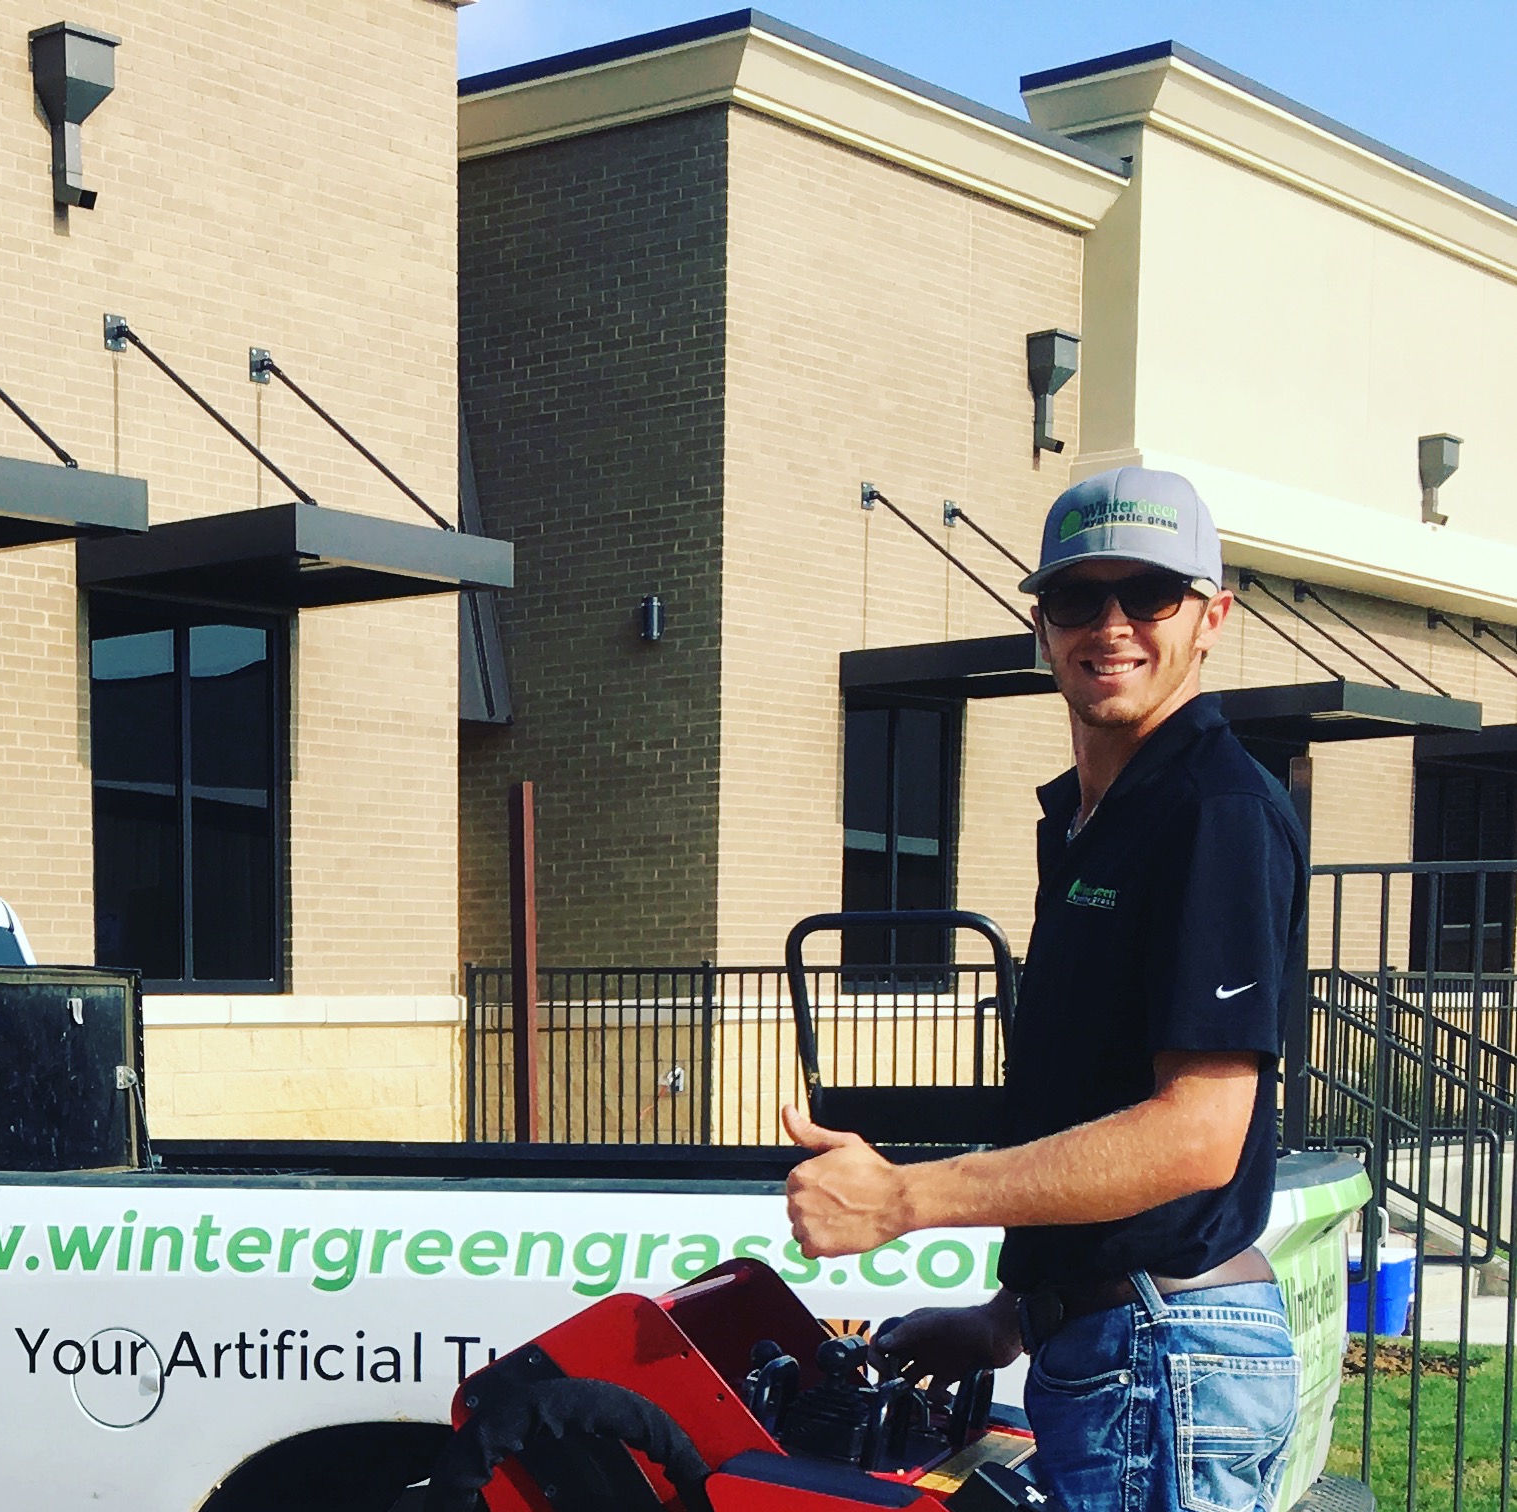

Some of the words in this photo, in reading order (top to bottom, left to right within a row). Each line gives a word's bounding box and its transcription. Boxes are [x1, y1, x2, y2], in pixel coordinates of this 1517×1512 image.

[1082, 498, 1178, 519] WinterGreen
[1147, 516, 1178, 529] grass
[15, 1327, 146, 1376] Your
[164, 1330, 422, 1383] Artificial
